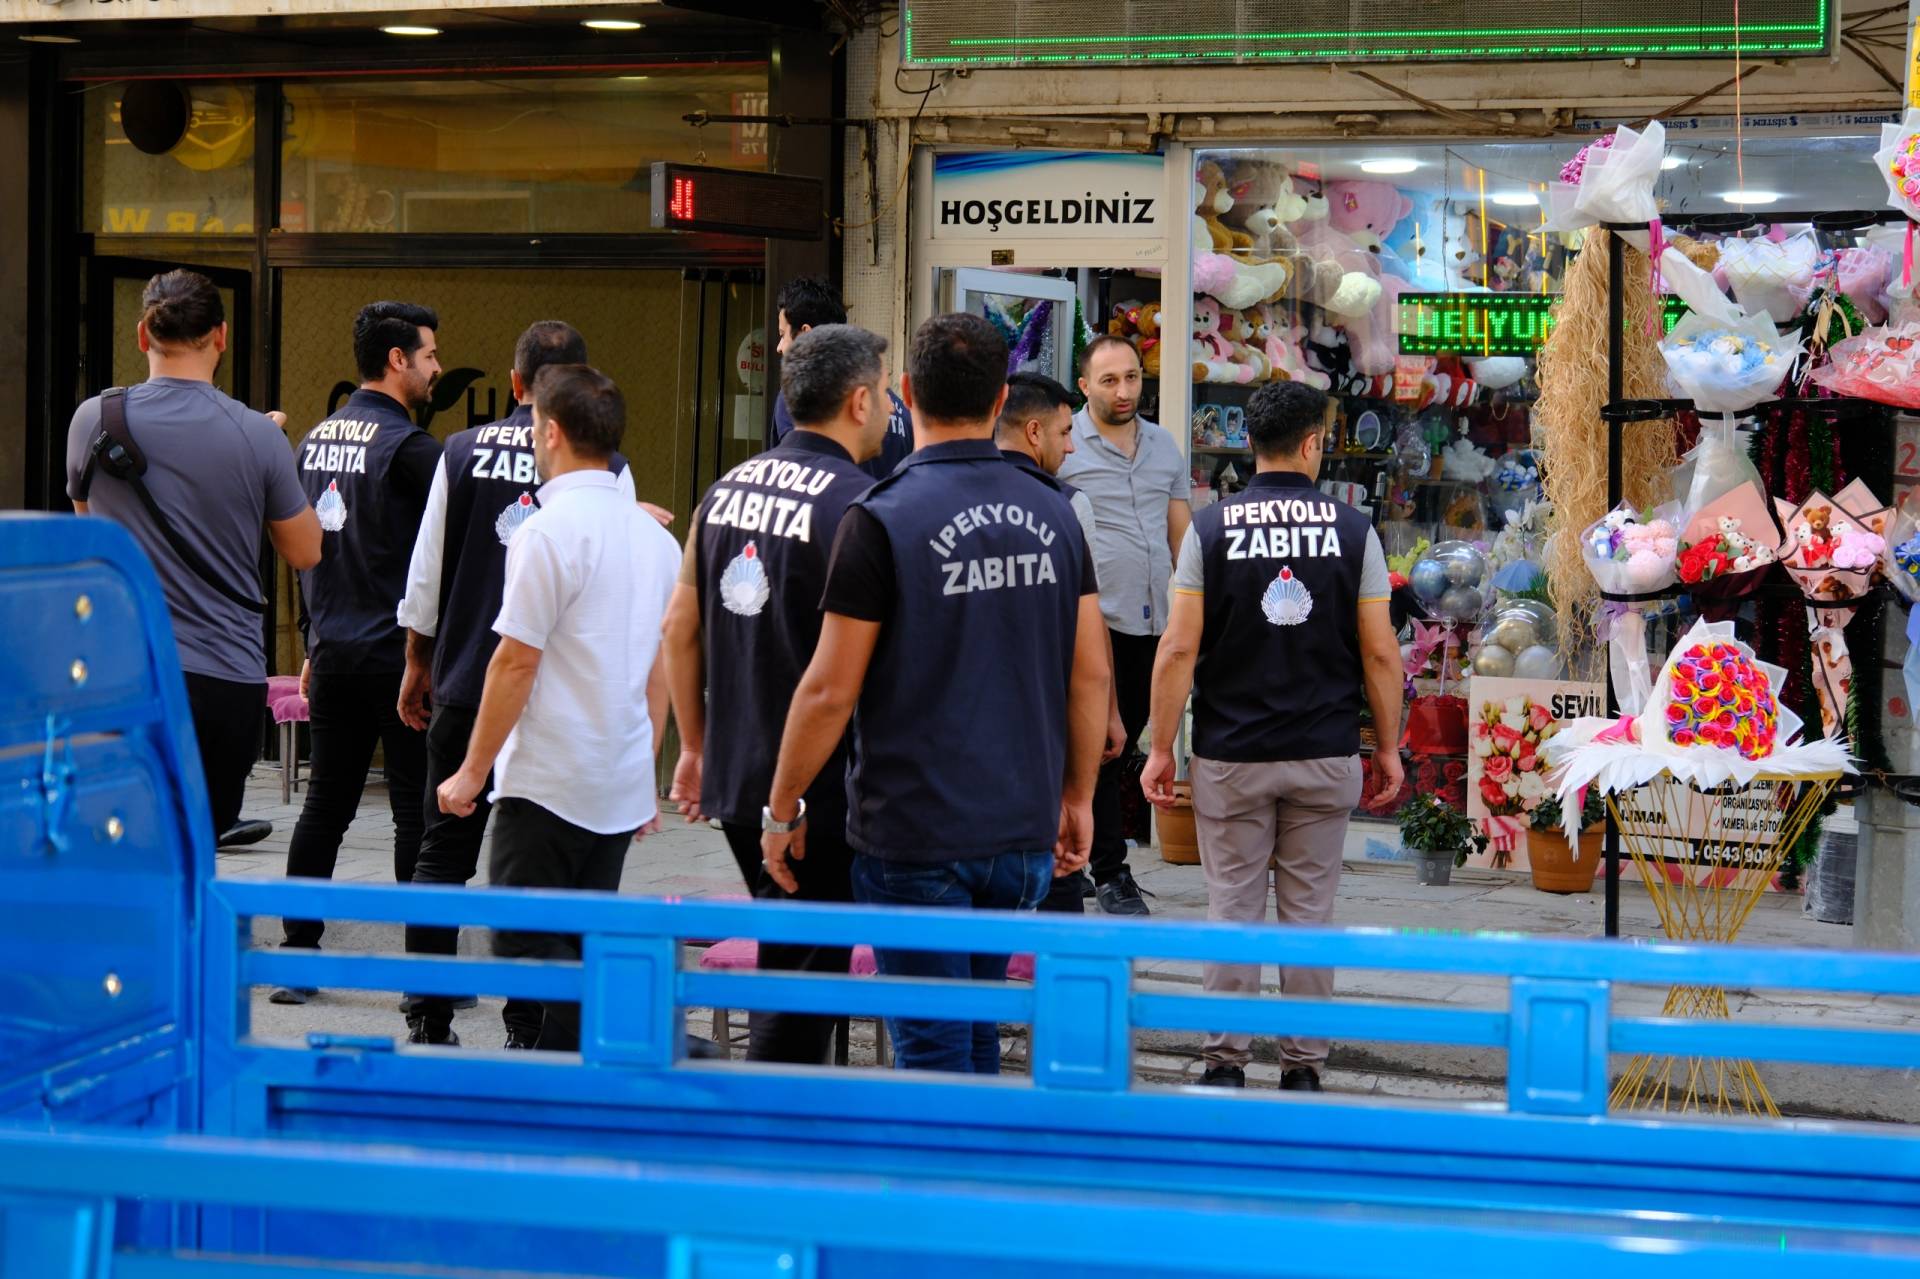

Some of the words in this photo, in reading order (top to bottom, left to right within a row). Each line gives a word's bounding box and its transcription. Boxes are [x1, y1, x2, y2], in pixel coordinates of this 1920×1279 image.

[941, 191, 1155, 232] HOŞGELDİNİZ
[304, 444, 366, 473] ZABITA
[706, 488, 813, 542] ZABITA
[929, 503, 1056, 558] İPEKYOLU
[1224, 500, 1337, 526] İPEKYOLU
[1225, 527, 1341, 560] ZABITA
[942, 553, 1057, 595] ZABITA
[1704, 845, 1740, 862] 0543
